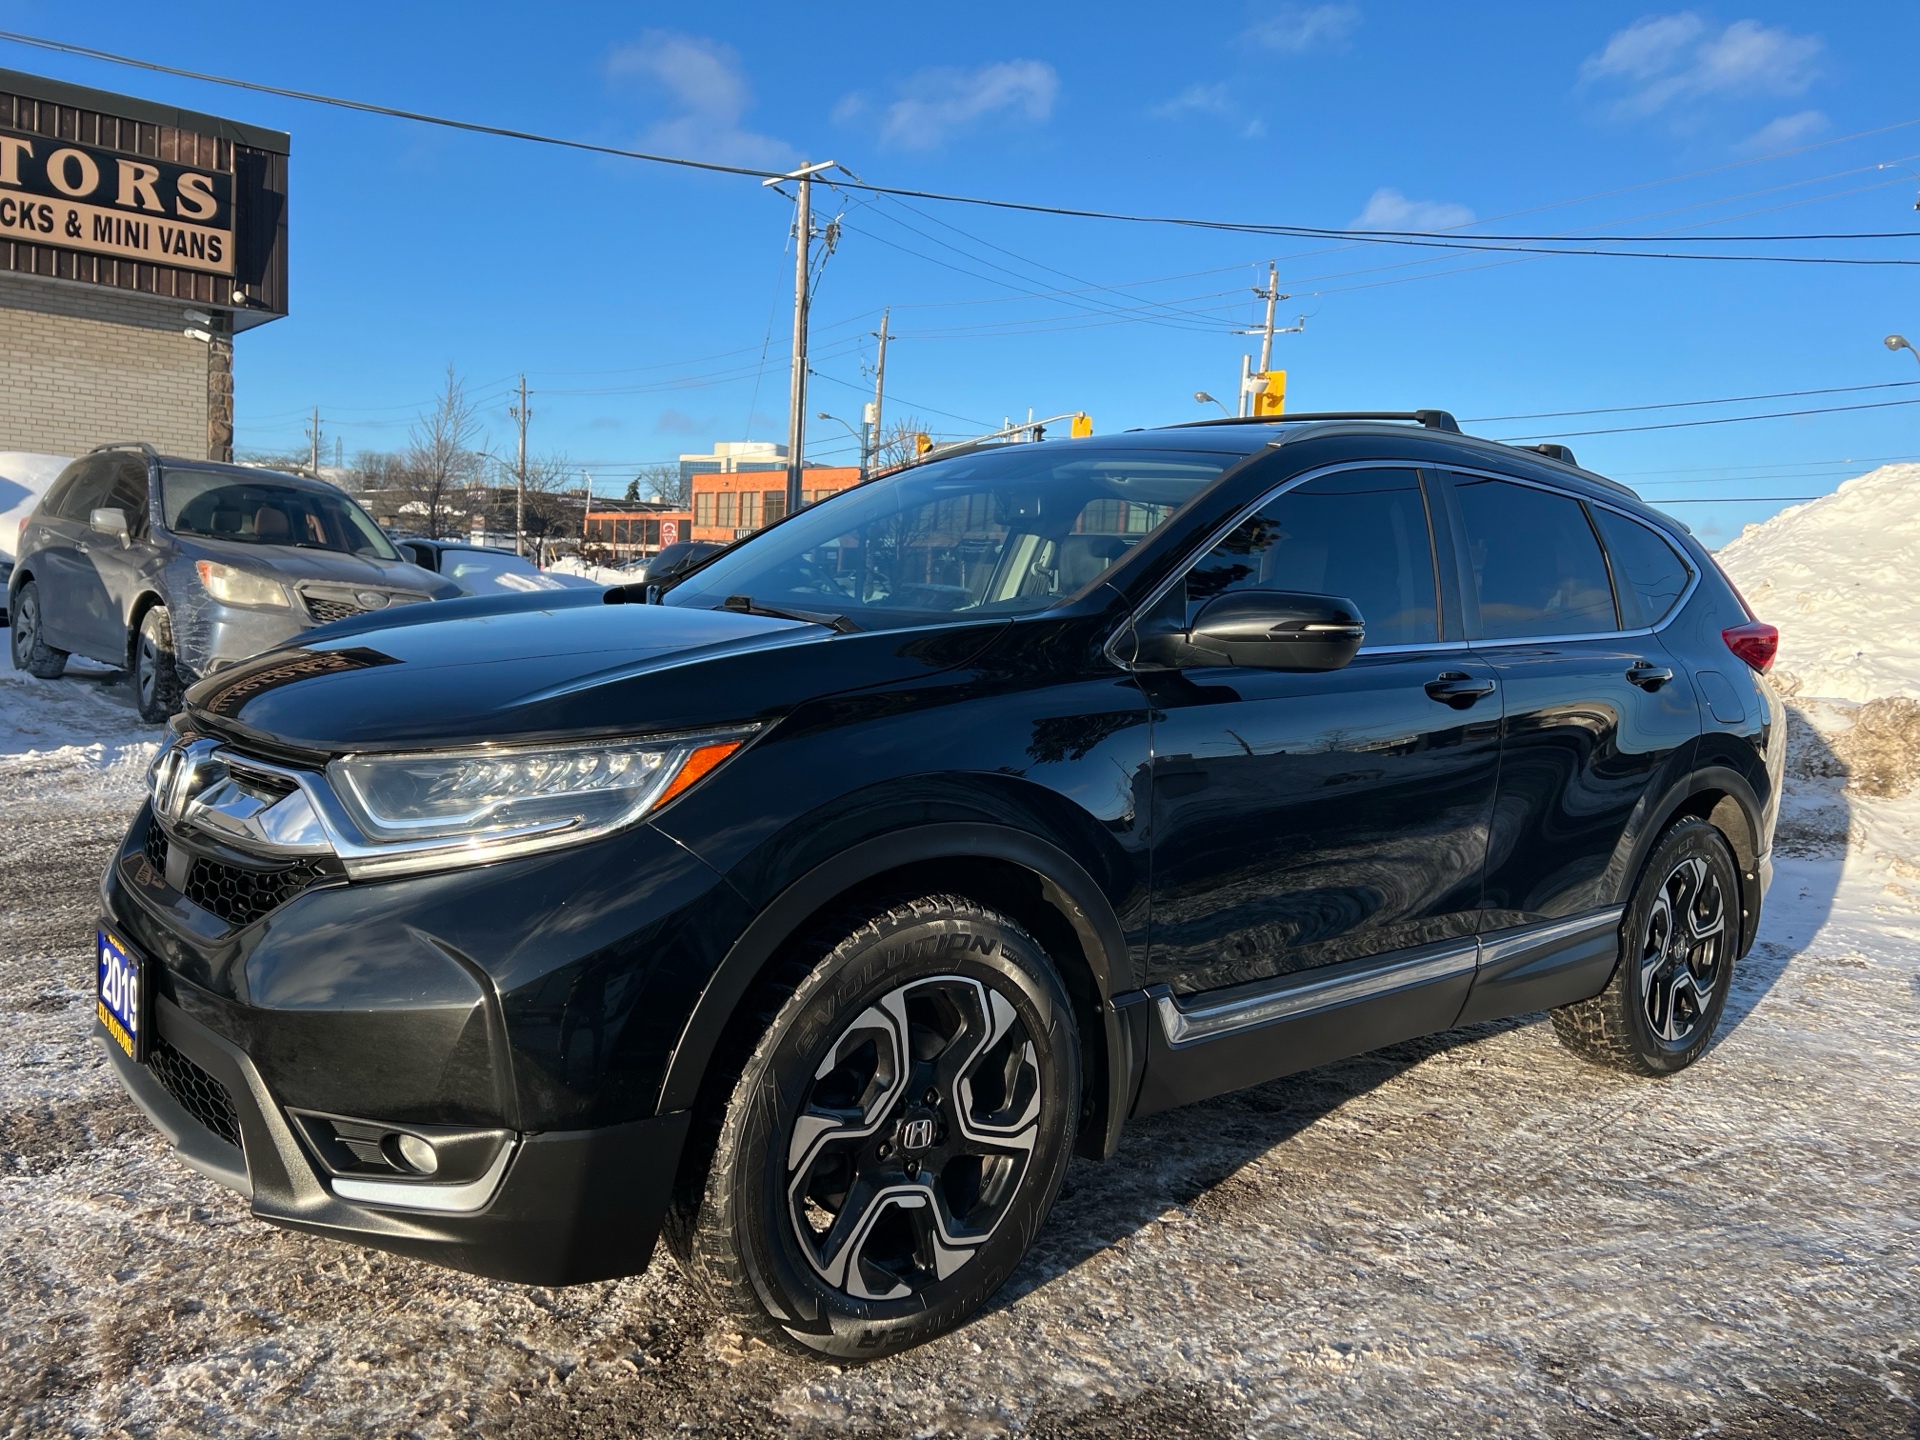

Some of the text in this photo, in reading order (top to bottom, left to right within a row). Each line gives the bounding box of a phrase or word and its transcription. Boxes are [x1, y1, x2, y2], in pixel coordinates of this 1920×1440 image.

[0, 136, 218, 220] TORS
[0, 197, 223, 262] CKS & MINI VANS
[102, 947, 137, 1032] 2019
[795, 932, 998, 1060] EVOLUTION
